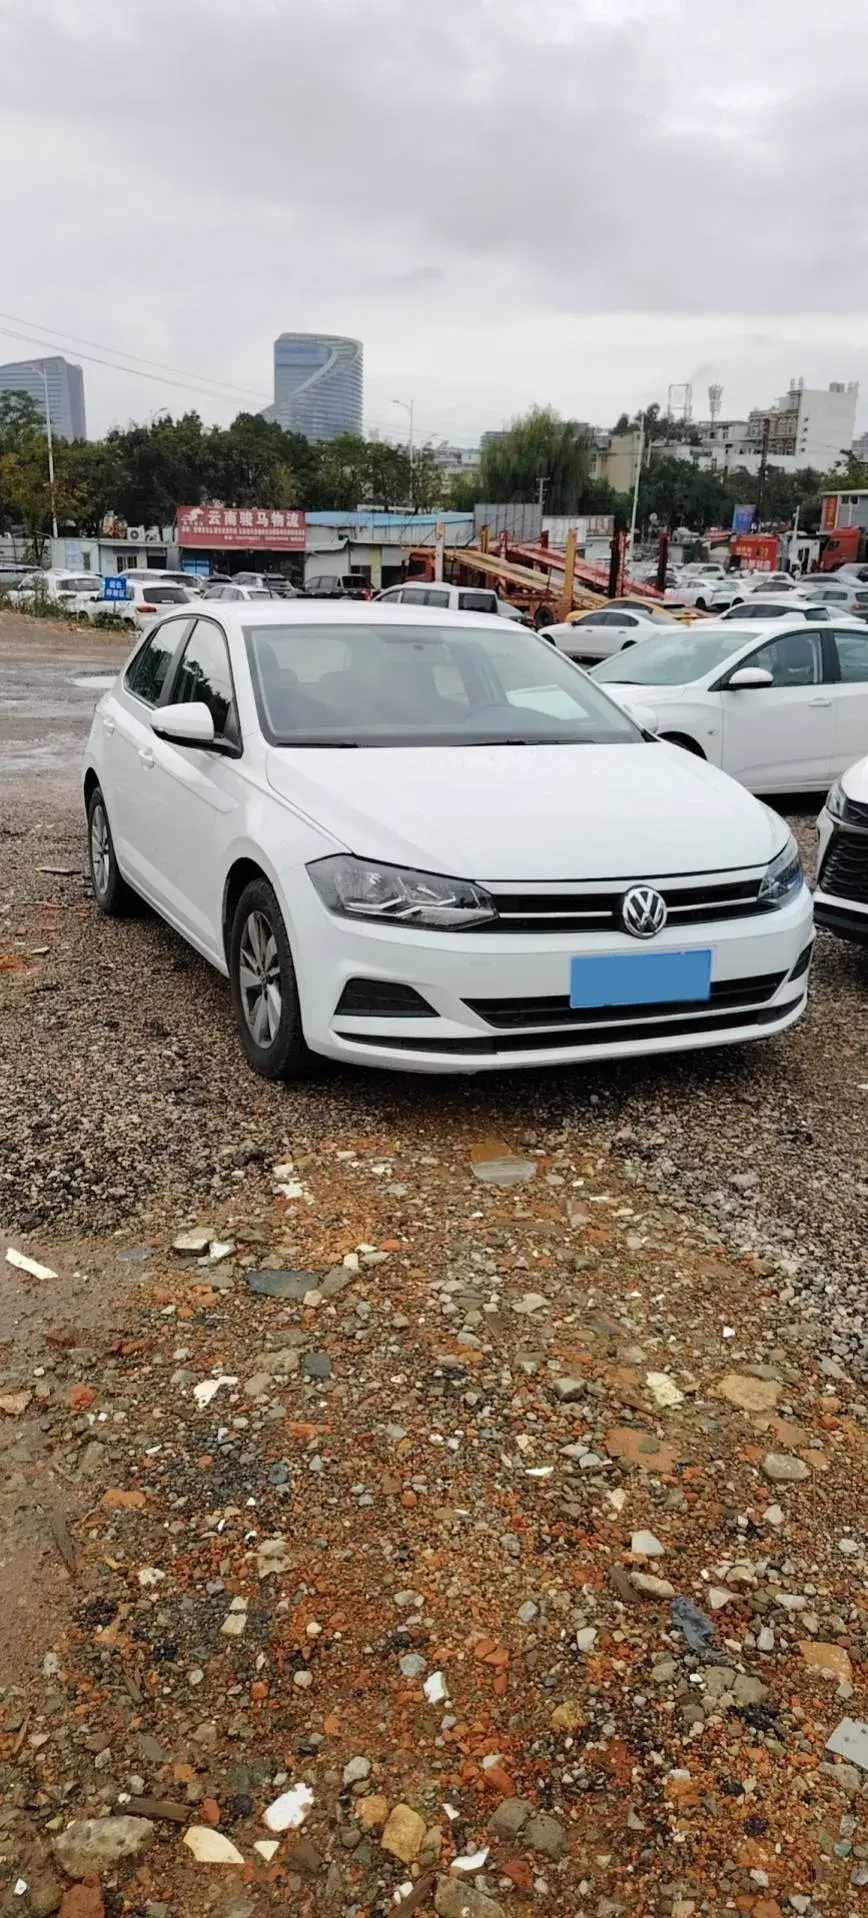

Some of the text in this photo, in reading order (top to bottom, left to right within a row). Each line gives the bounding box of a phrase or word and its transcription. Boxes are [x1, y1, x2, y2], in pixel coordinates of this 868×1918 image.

[207, 510, 300, 528] 云南骏马物流
